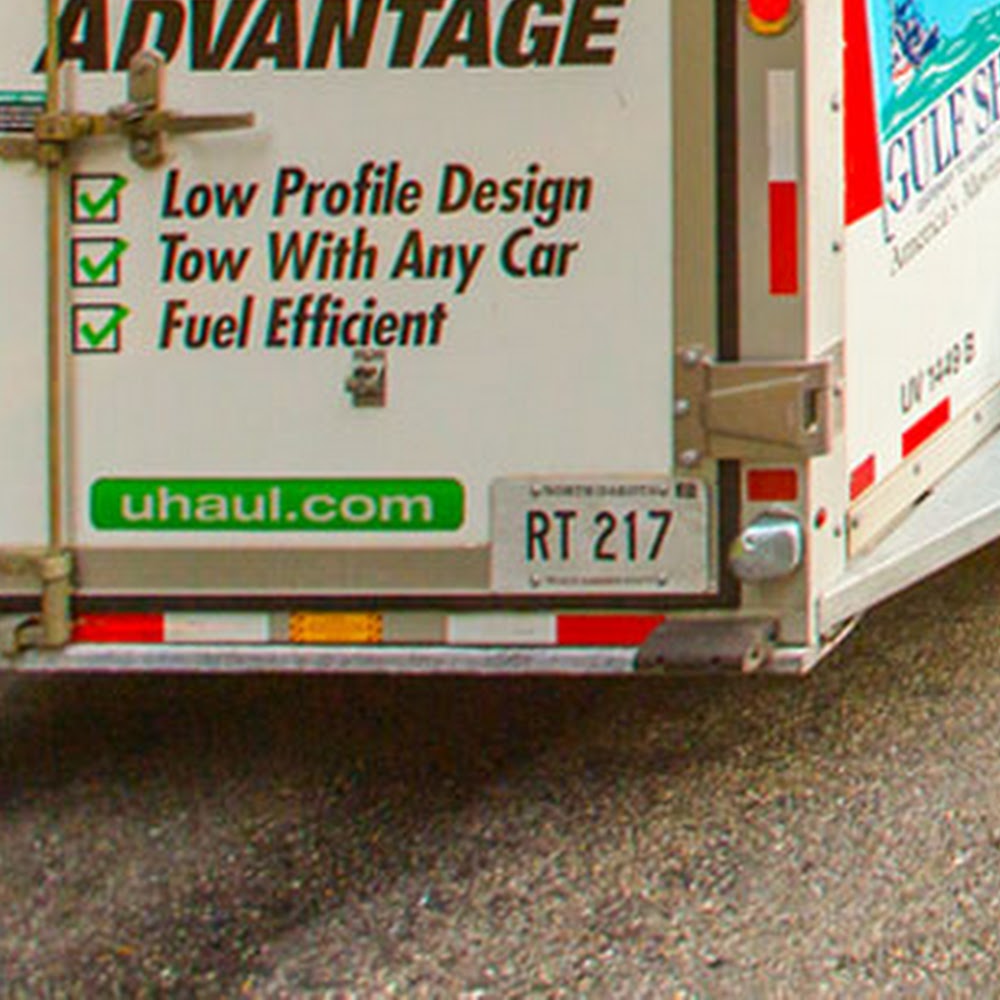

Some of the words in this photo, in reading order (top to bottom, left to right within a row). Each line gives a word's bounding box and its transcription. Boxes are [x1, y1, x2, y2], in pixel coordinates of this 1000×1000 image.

[881, 84, 965, 213] GULF
[162, 168, 257, 220] Low
[273, 161, 421, 215] Profile
[438, 164, 592, 228] Design
[159, 234, 249, 284] Tow
[268, 229, 378, 282] With
[391, 230, 485, 294] Any
[500, 227, 579, 277] Car
[159, 297, 255, 349] Fuel
[265, 294, 448, 348] Efficient
[900, 370, 924, 414] UV
[120, 488, 434, 524] uhaul.com
[526, 509, 579, 561] RT
[593, 509, 674, 561] 217
